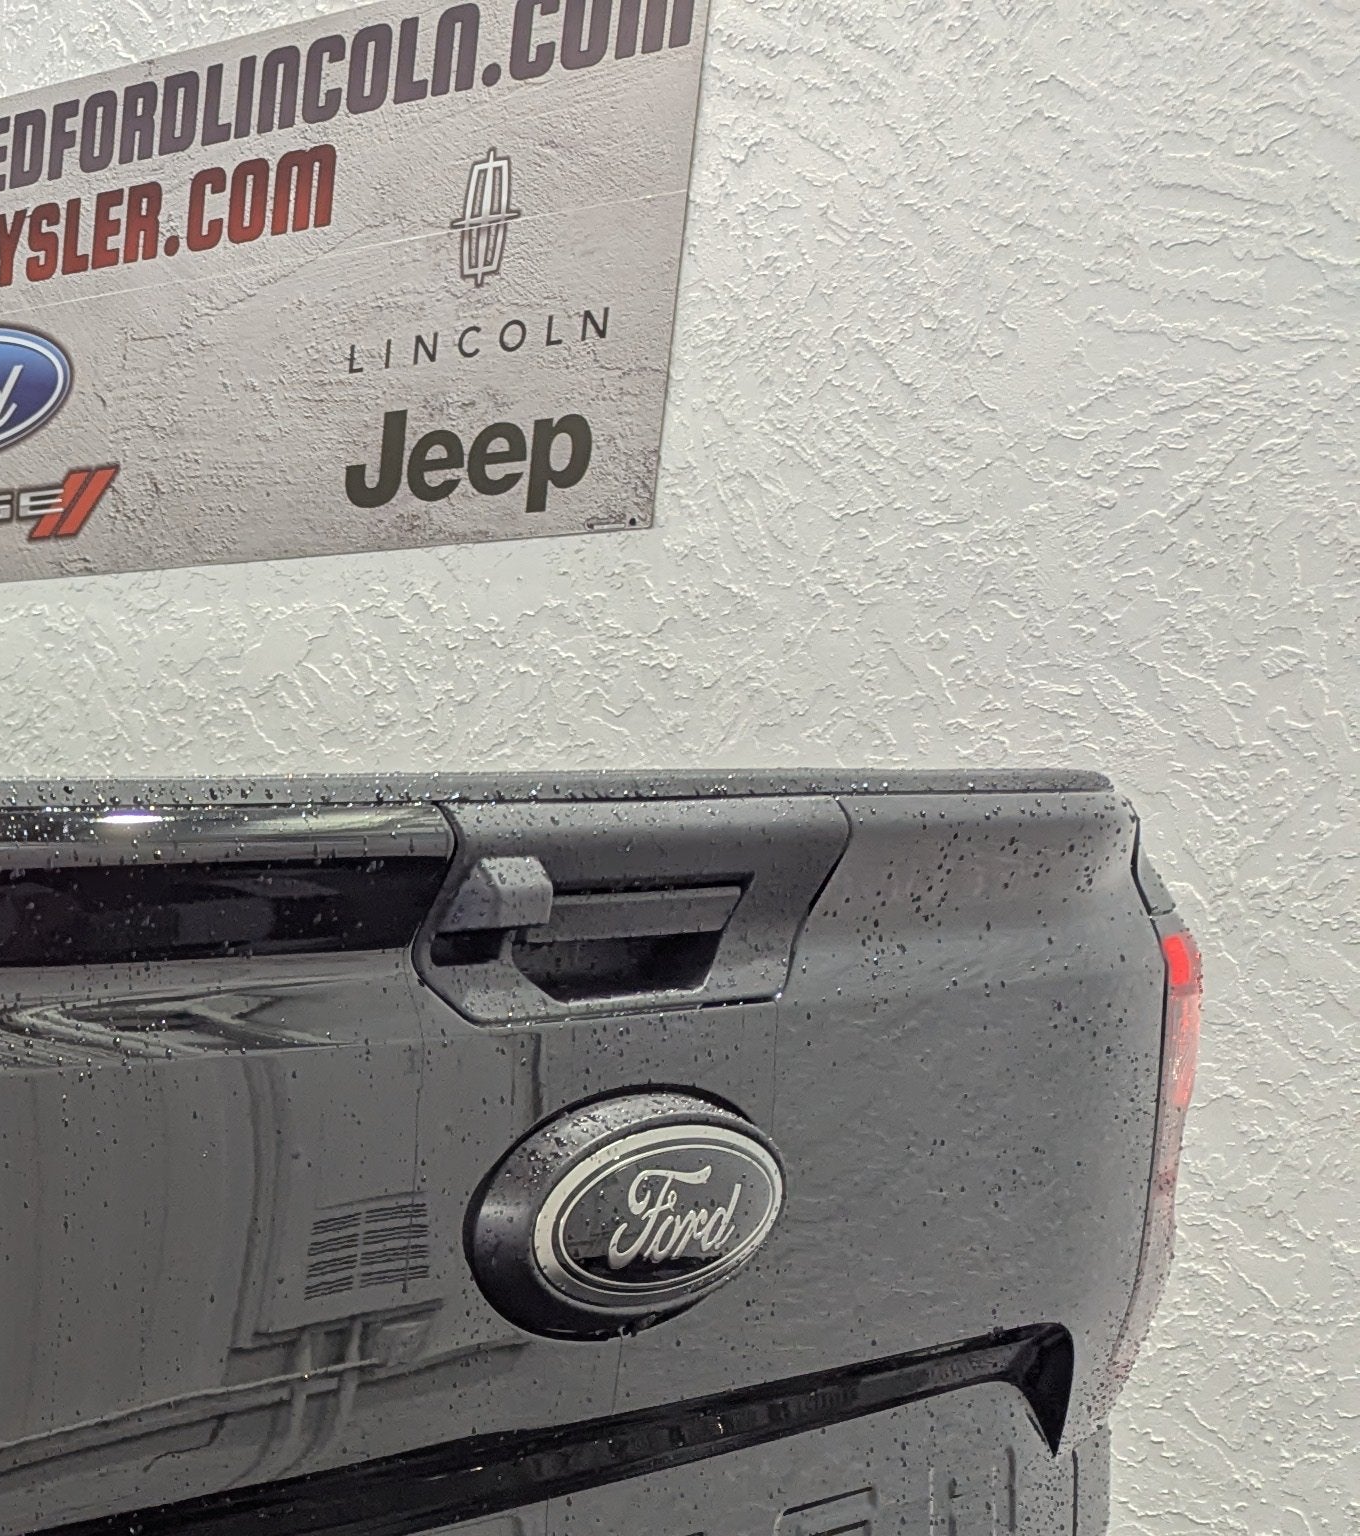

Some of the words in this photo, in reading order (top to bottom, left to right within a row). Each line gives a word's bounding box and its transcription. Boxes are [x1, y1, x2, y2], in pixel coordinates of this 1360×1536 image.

[348, 307, 610, 374] LINCOLN
[345, 409, 593, 513] Jeep
[608, 1165, 742, 1270] Ford
